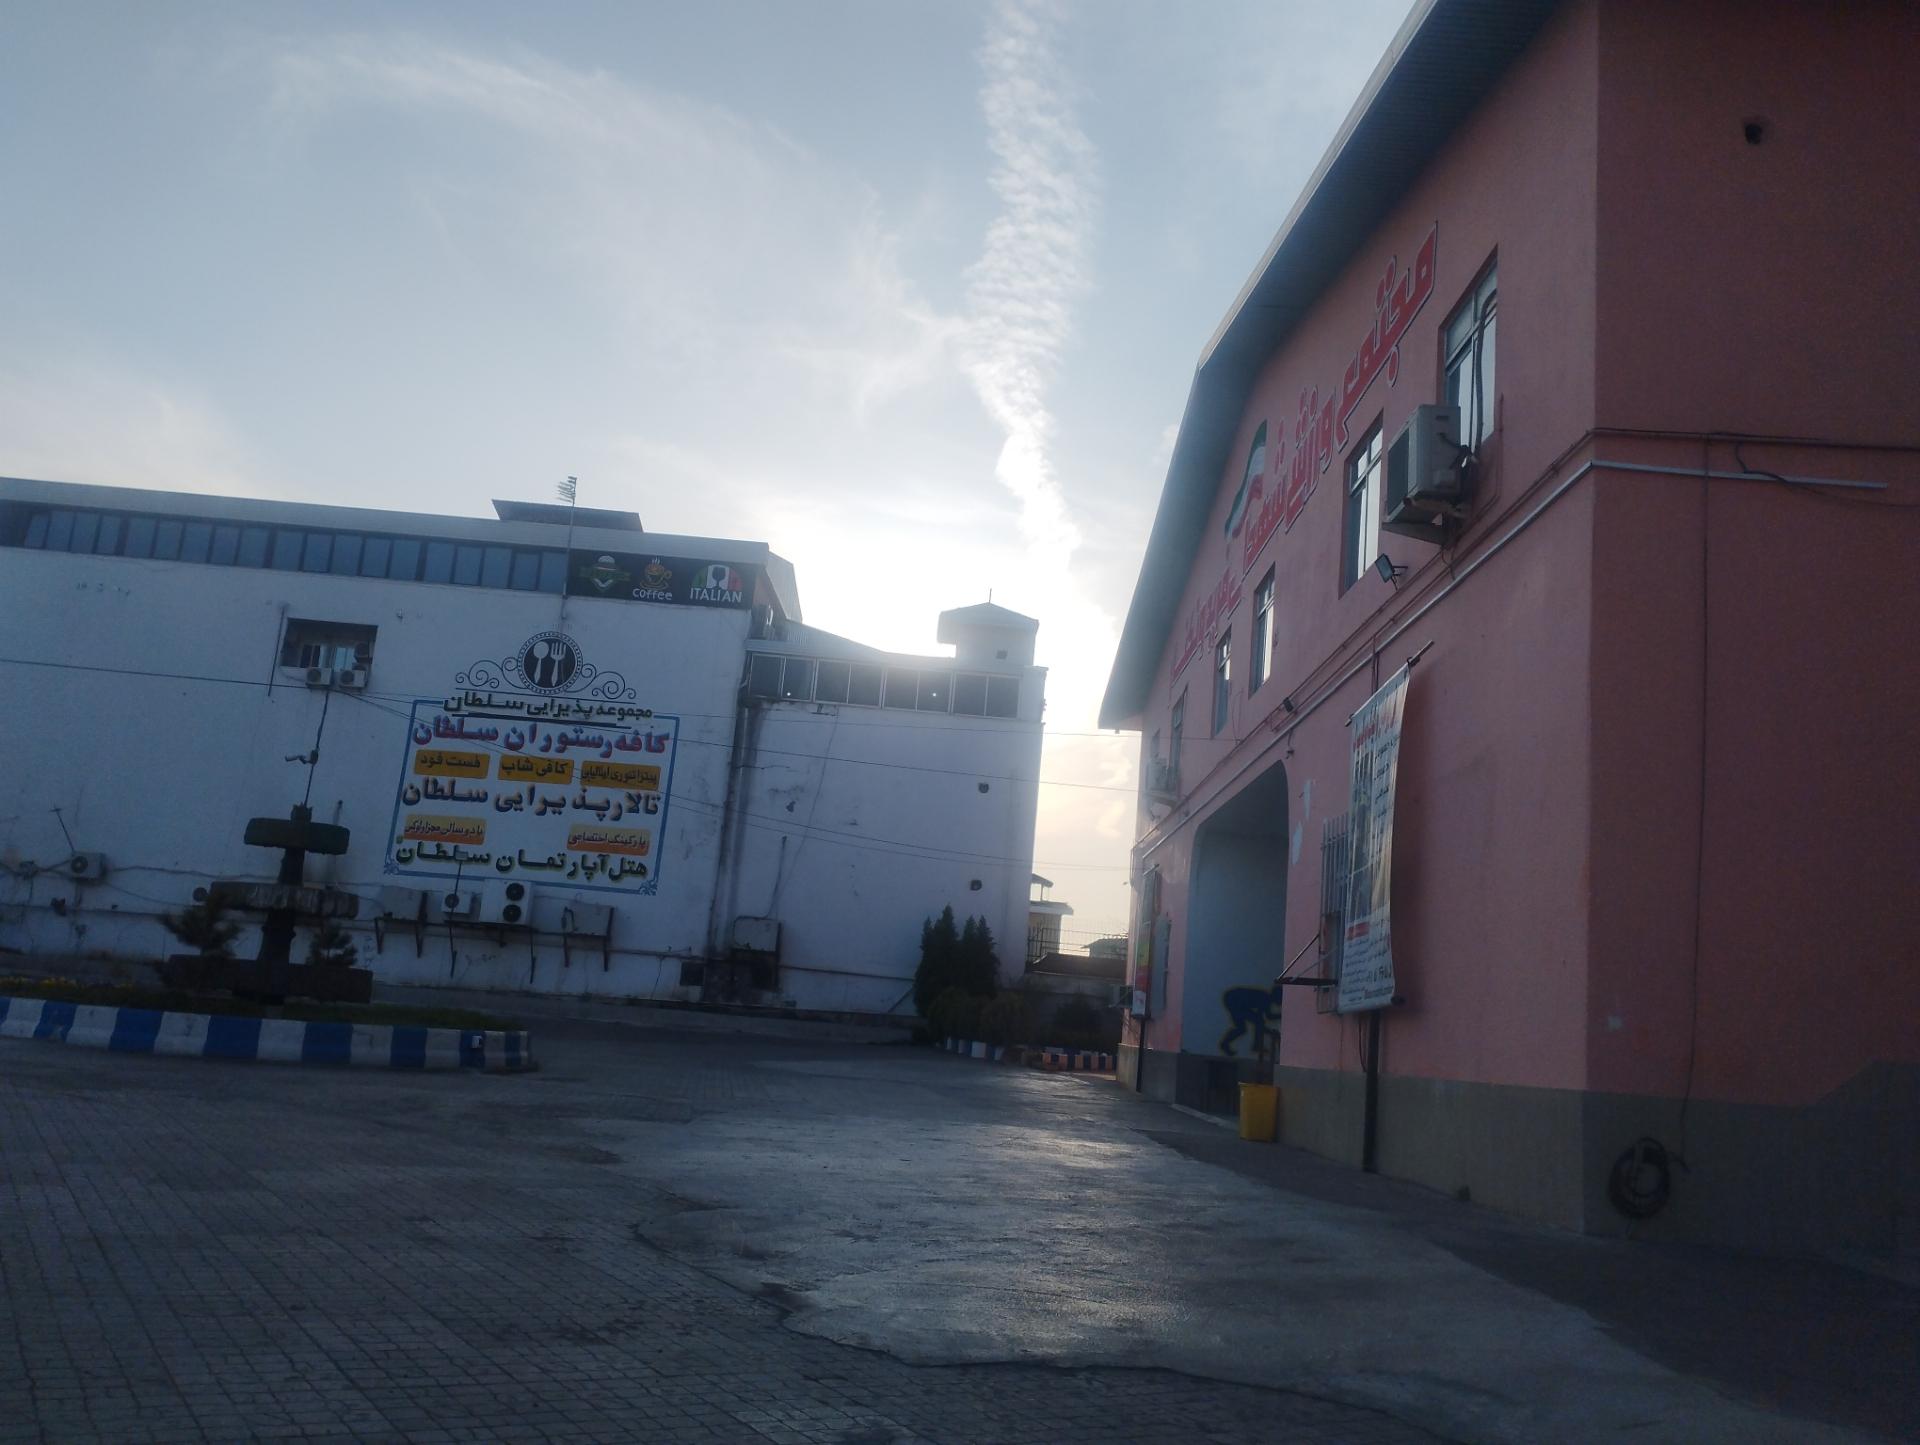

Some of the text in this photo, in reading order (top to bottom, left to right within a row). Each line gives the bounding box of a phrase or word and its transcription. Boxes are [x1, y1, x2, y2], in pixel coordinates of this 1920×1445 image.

[1336, 220, 1439, 452] مجتمع
[1285, 385, 1336, 533] ورزشی
[689, 586, 743, 604] ITALIAN
[443, 690, 654, 722] مجموعه پذیرایی سلطان
[412, 714, 670, 758] کافه رستوران سلطان
[419, 751, 481, 769] فست فود
[499, 757, 570, 778] کافی شاپ
[402, 775, 662, 823] تالار پذیرایی سلطان
[607, 832, 647, 849] پارکینگ
[395, 838, 649, 882] هتل آپارتمان سلطان
